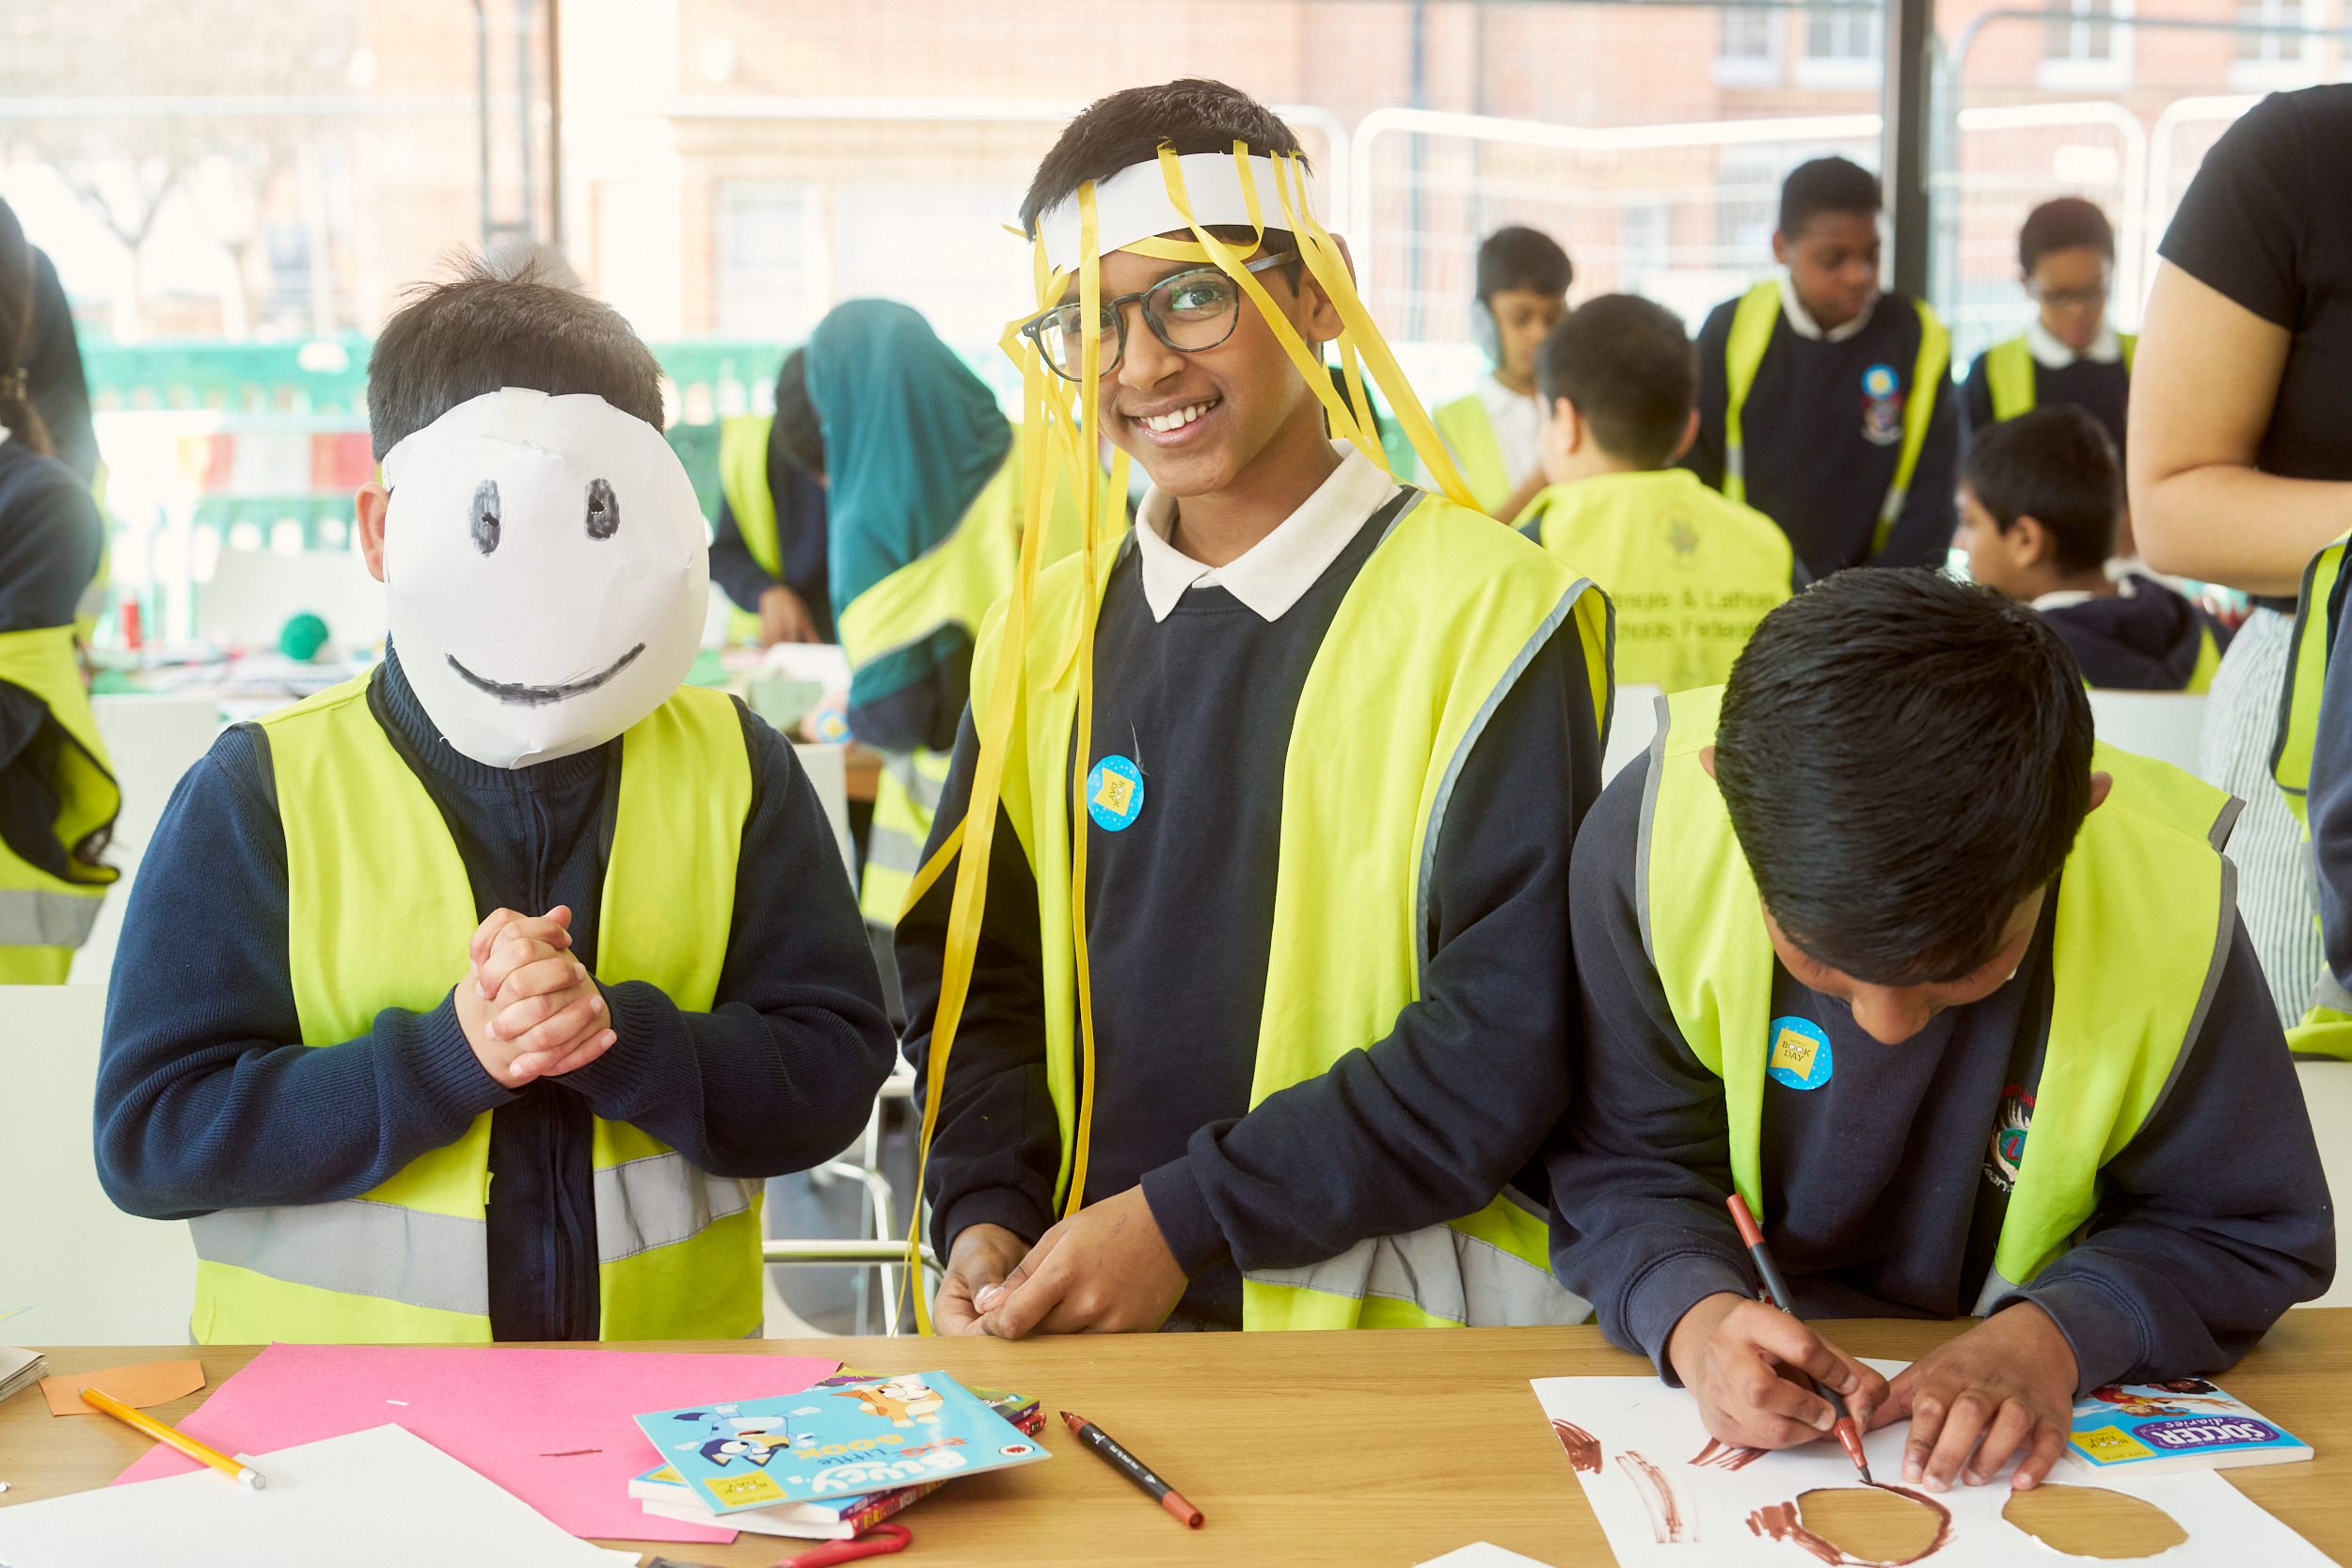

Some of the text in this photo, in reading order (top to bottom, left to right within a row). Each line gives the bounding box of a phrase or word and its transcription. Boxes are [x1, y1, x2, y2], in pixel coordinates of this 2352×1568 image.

[1109, 782, 1118, 800] DAY
[1113, 781, 1124, 807] BOOK
[1782, 1040, 1811, 1057] BOOK
[1789, 1038, 1807, 1047] WORLD
[1784, 1050, 1804, 1062] DAY
[2166, 1417, 2224, 1428] diaries
[2151, 1423, 2266, 1445] SOCCER
[791, 1433, 905, 1460] BOOK
[2088, 1438, 2129, 1449] BOOK
